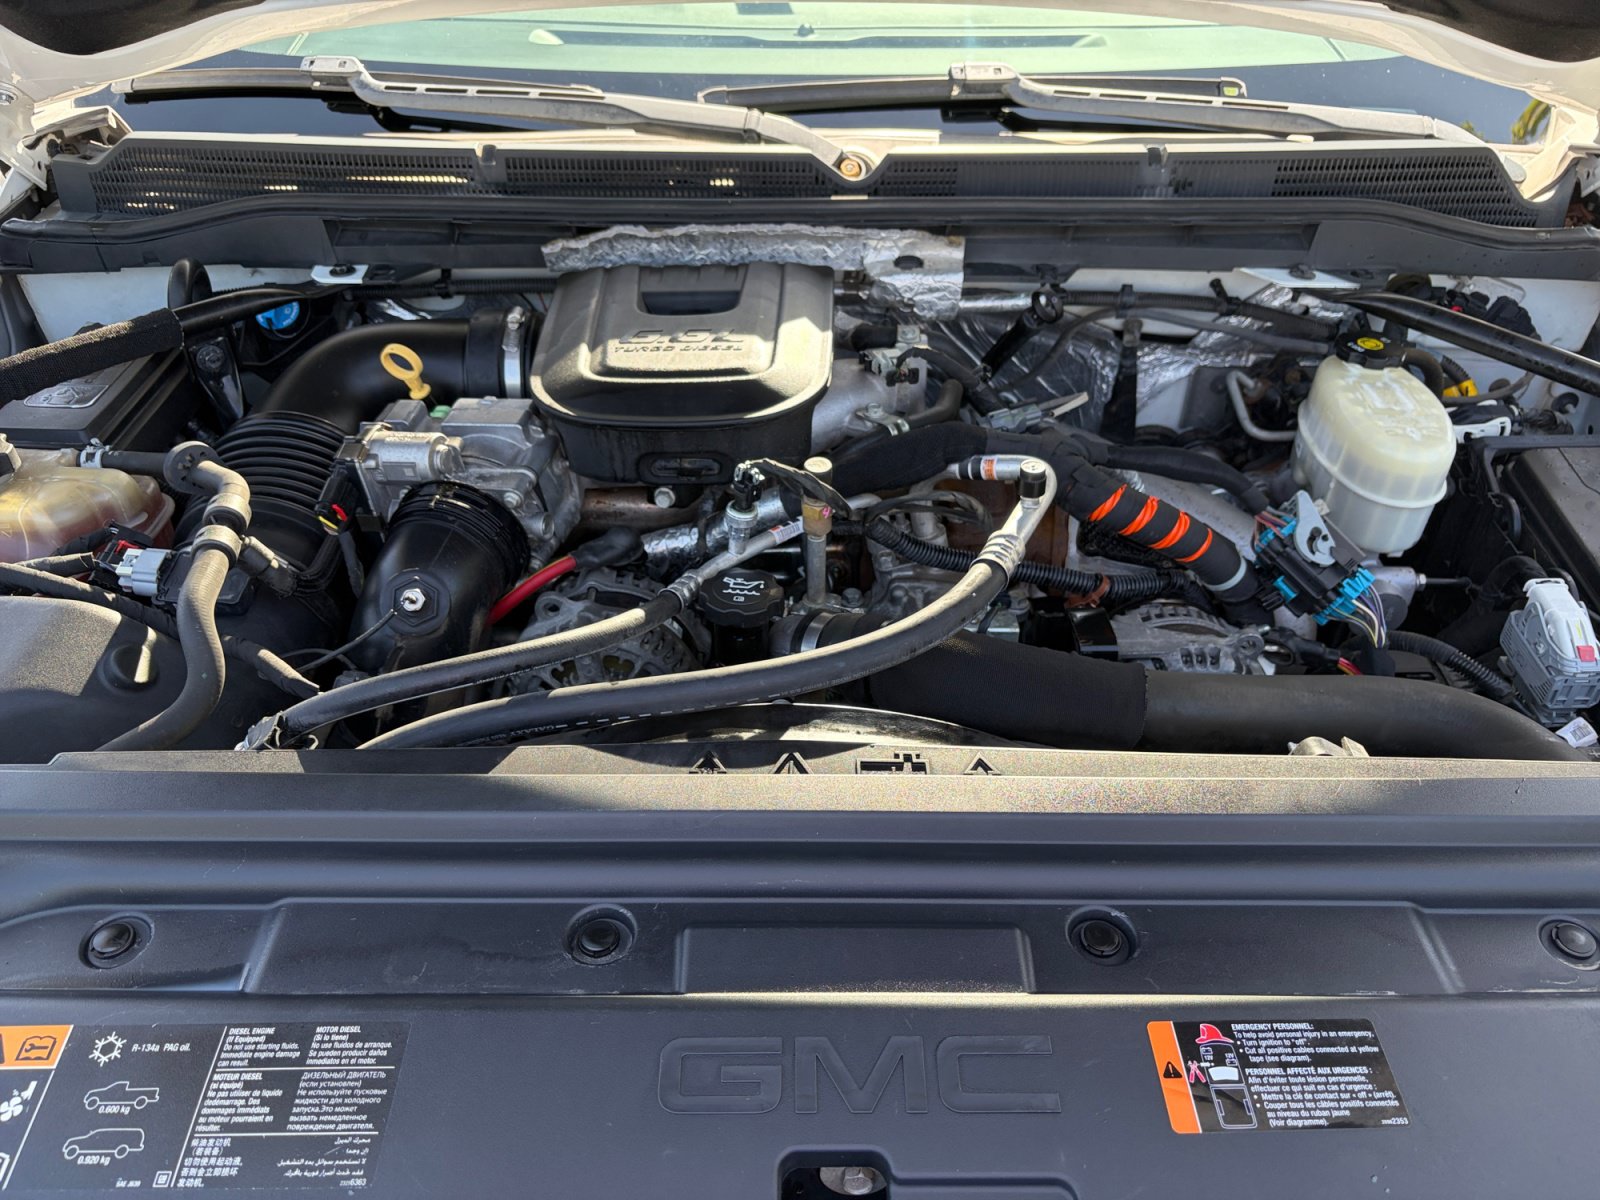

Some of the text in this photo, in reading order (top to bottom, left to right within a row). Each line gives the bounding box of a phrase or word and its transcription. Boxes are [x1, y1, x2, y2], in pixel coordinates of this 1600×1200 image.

[614, 344, 743, 353] TURBO DIESEL
[1271, 1022, 1314, 1030] PERSONNEL:
[229, 1027, 275, 1035] DIESEL ENGINE
[1242, 1031, 1257, 1039] help
[1275, 1030, 1302, 1039] personal
[1302, 1030, 1321, 1039] injury
[234, 1035, 266, 1044] Equipped)
[1258, 1039, 1283, 1047] ignition
[131, 1043, 192, 1051] R-134a PAG oil.
[256, 1043, 280, 1051] starting
[281, 1042, 299, 1050] fluids.
[1267, 1046, 1292, 1055] positive
[1357, 1045, 1379, 1054] yellow
[253, 1051, 275, 1059] engine
[275, 1050, 301, 1059] damage
[341, 1049, 368, 1057] producir
[230, 1059, 249, 1067] result.
[1249, 1055, 1312, 1063] tape (see diagram).
[301, 1070, 387, 1079] ДИЗЕЛЬНЫЙ ДВИГАТЕЛЬ
[657, 1034, 1062, 1114] GMC
[1245, 1067, 1286, 1075] PERSONNEL
[1286, 1066, 1317, 1075] AFFECTÉ
[213, 1072, 262, 1081] MOTEUR DIESEL
[1327, 1075, 1369, 1083] personnelle,
[299, 1079, 362, 1088] (если установлен)
[1291, 1084, 1302, 1092] qui
[216, 1090, 229, 1098] pas
[261, 1089, 283, 1098] liquide
[307, 1089, 352, 1097] используйте
[248, 1097, 261, 1105] Des
[1263, 1101, 1288, 1109] Couper
[1316, 1100, 1339, 1108] câbles
[1339, 1100, 1364, 1108] positifs
[98, 1105, 131, 1115] 0.600 kg
[201, 1107, 236, 1115] dommages
[1300, 1109, 1310, 1117] du
[1310, 1109, 1331, 1117] ruban
[1331, 1109, 1351, 1118] jaune
[230, 1115, 264, 1124] pourraient
[319, 1114, 368, 1122] немедленное
[1269, 1118, 1329, 1127] (Voir diagramme).
[286, 1123, 336, 1131] повреждение
[77, 1155, 111, 1165] 0.920 kg
